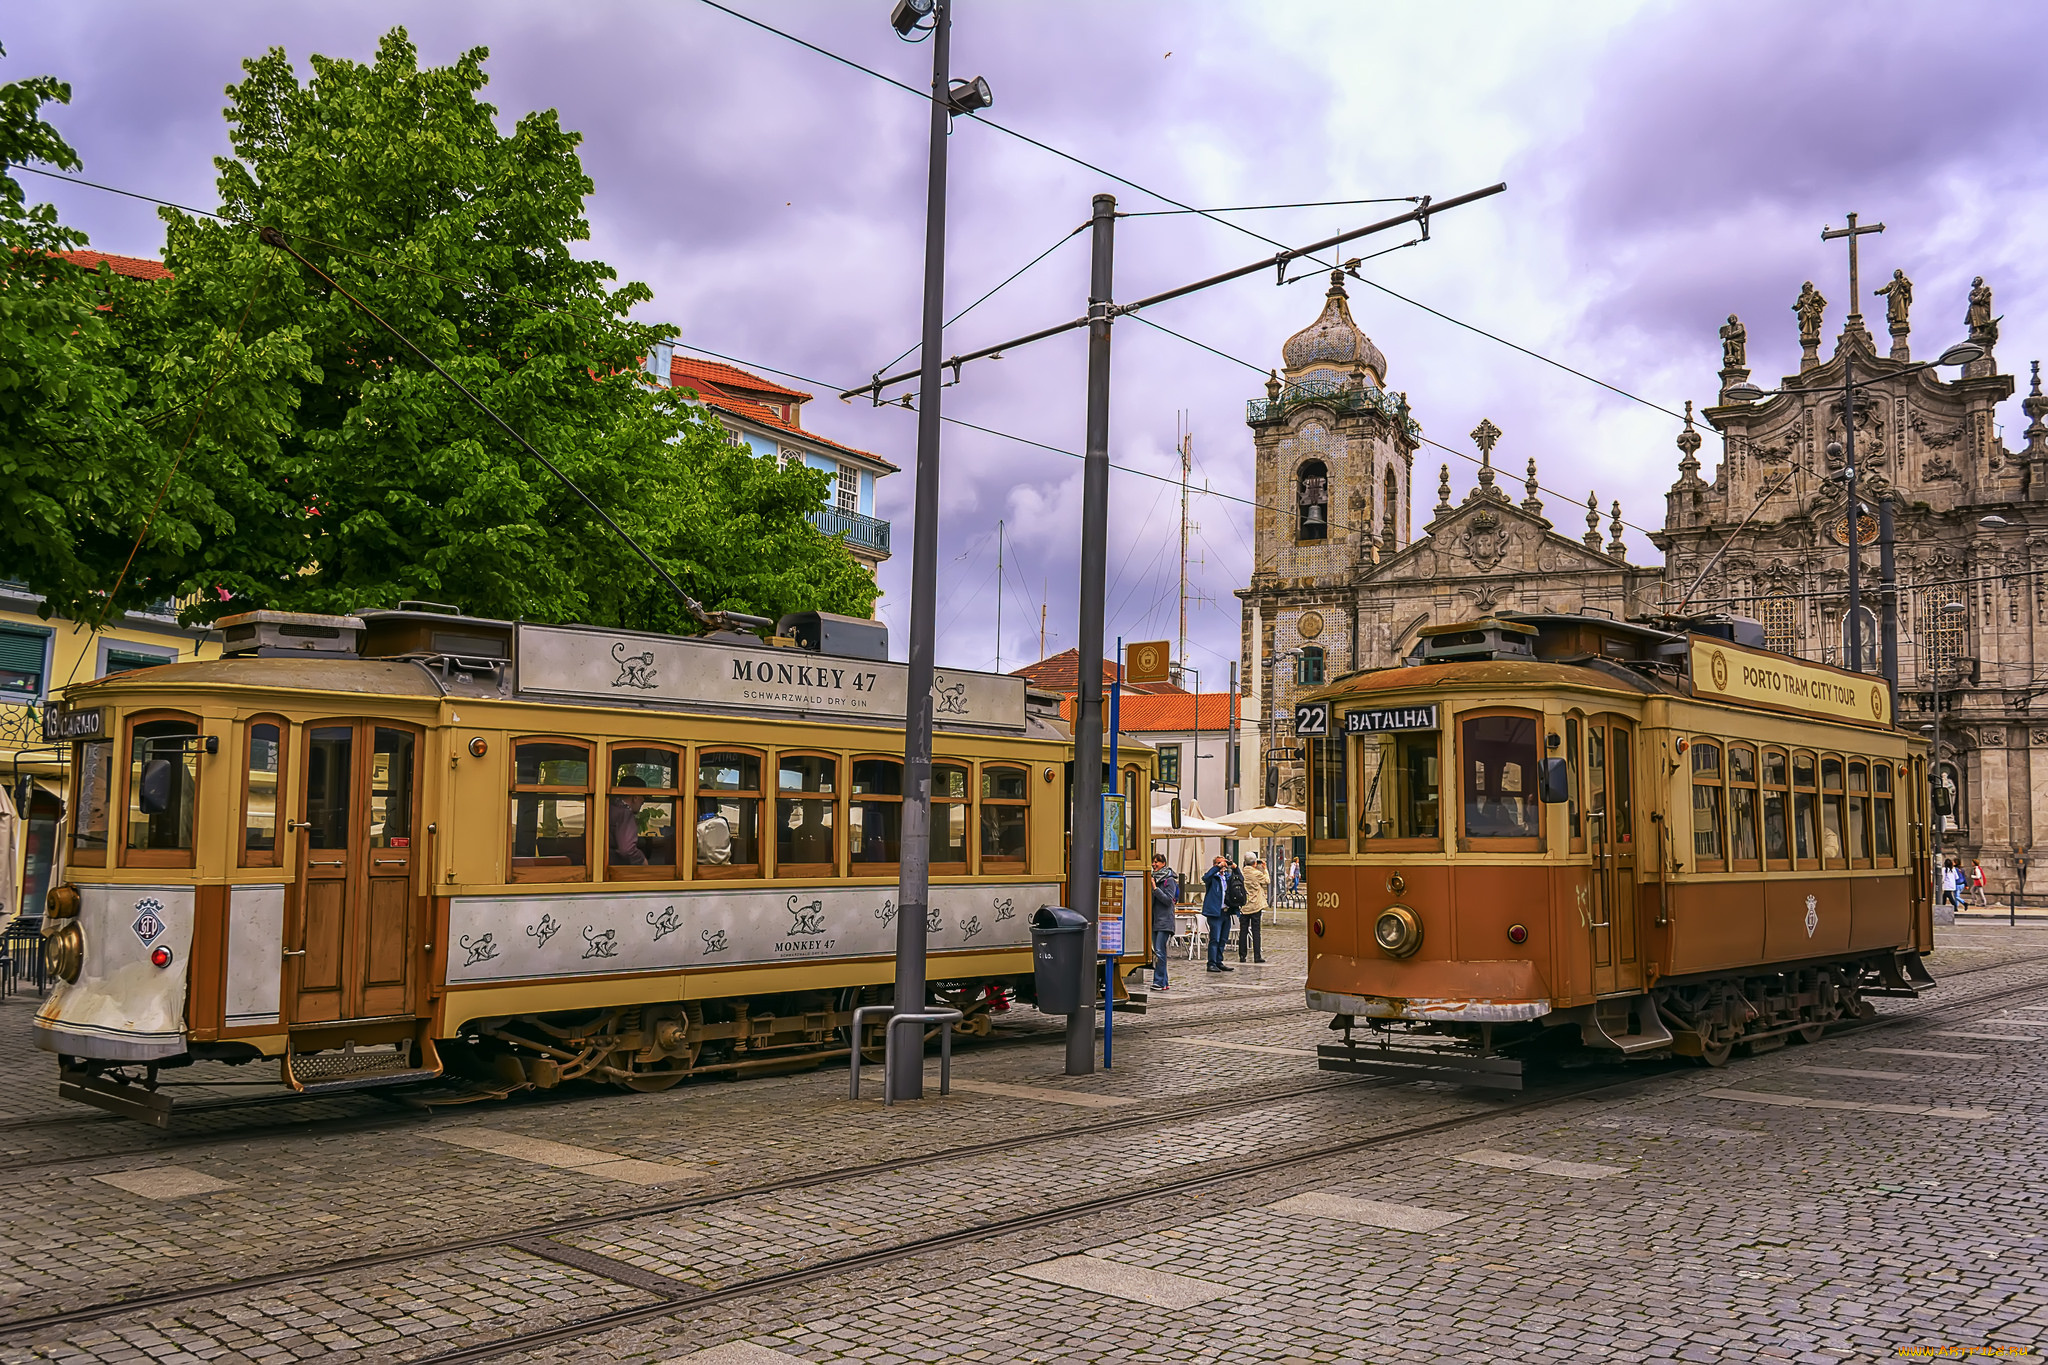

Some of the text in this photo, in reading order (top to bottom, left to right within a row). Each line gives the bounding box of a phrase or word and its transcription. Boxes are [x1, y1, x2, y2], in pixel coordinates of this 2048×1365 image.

[731, 659, 877, 692] MONKEY 47
[1743, 665, 1781, 691] PORTO
[1783, 674, 1809, 698] TRAM
[1811, 680, 1832, 701] CITY
[1834, 685, 1856, 707] TOUR
[743, 690, 867, 707] SCHWARZWALD DRY GIN
[46, 708, 58, 737] 18
[60, 713, 100, 736] CARMO
[1297, 707, 1325, 733] 22
[1348, 709, 1429, 731] BATALHA
[1316, 891, 1340, 909] 220
[774, 940, 836, 952] MONKEY 47
